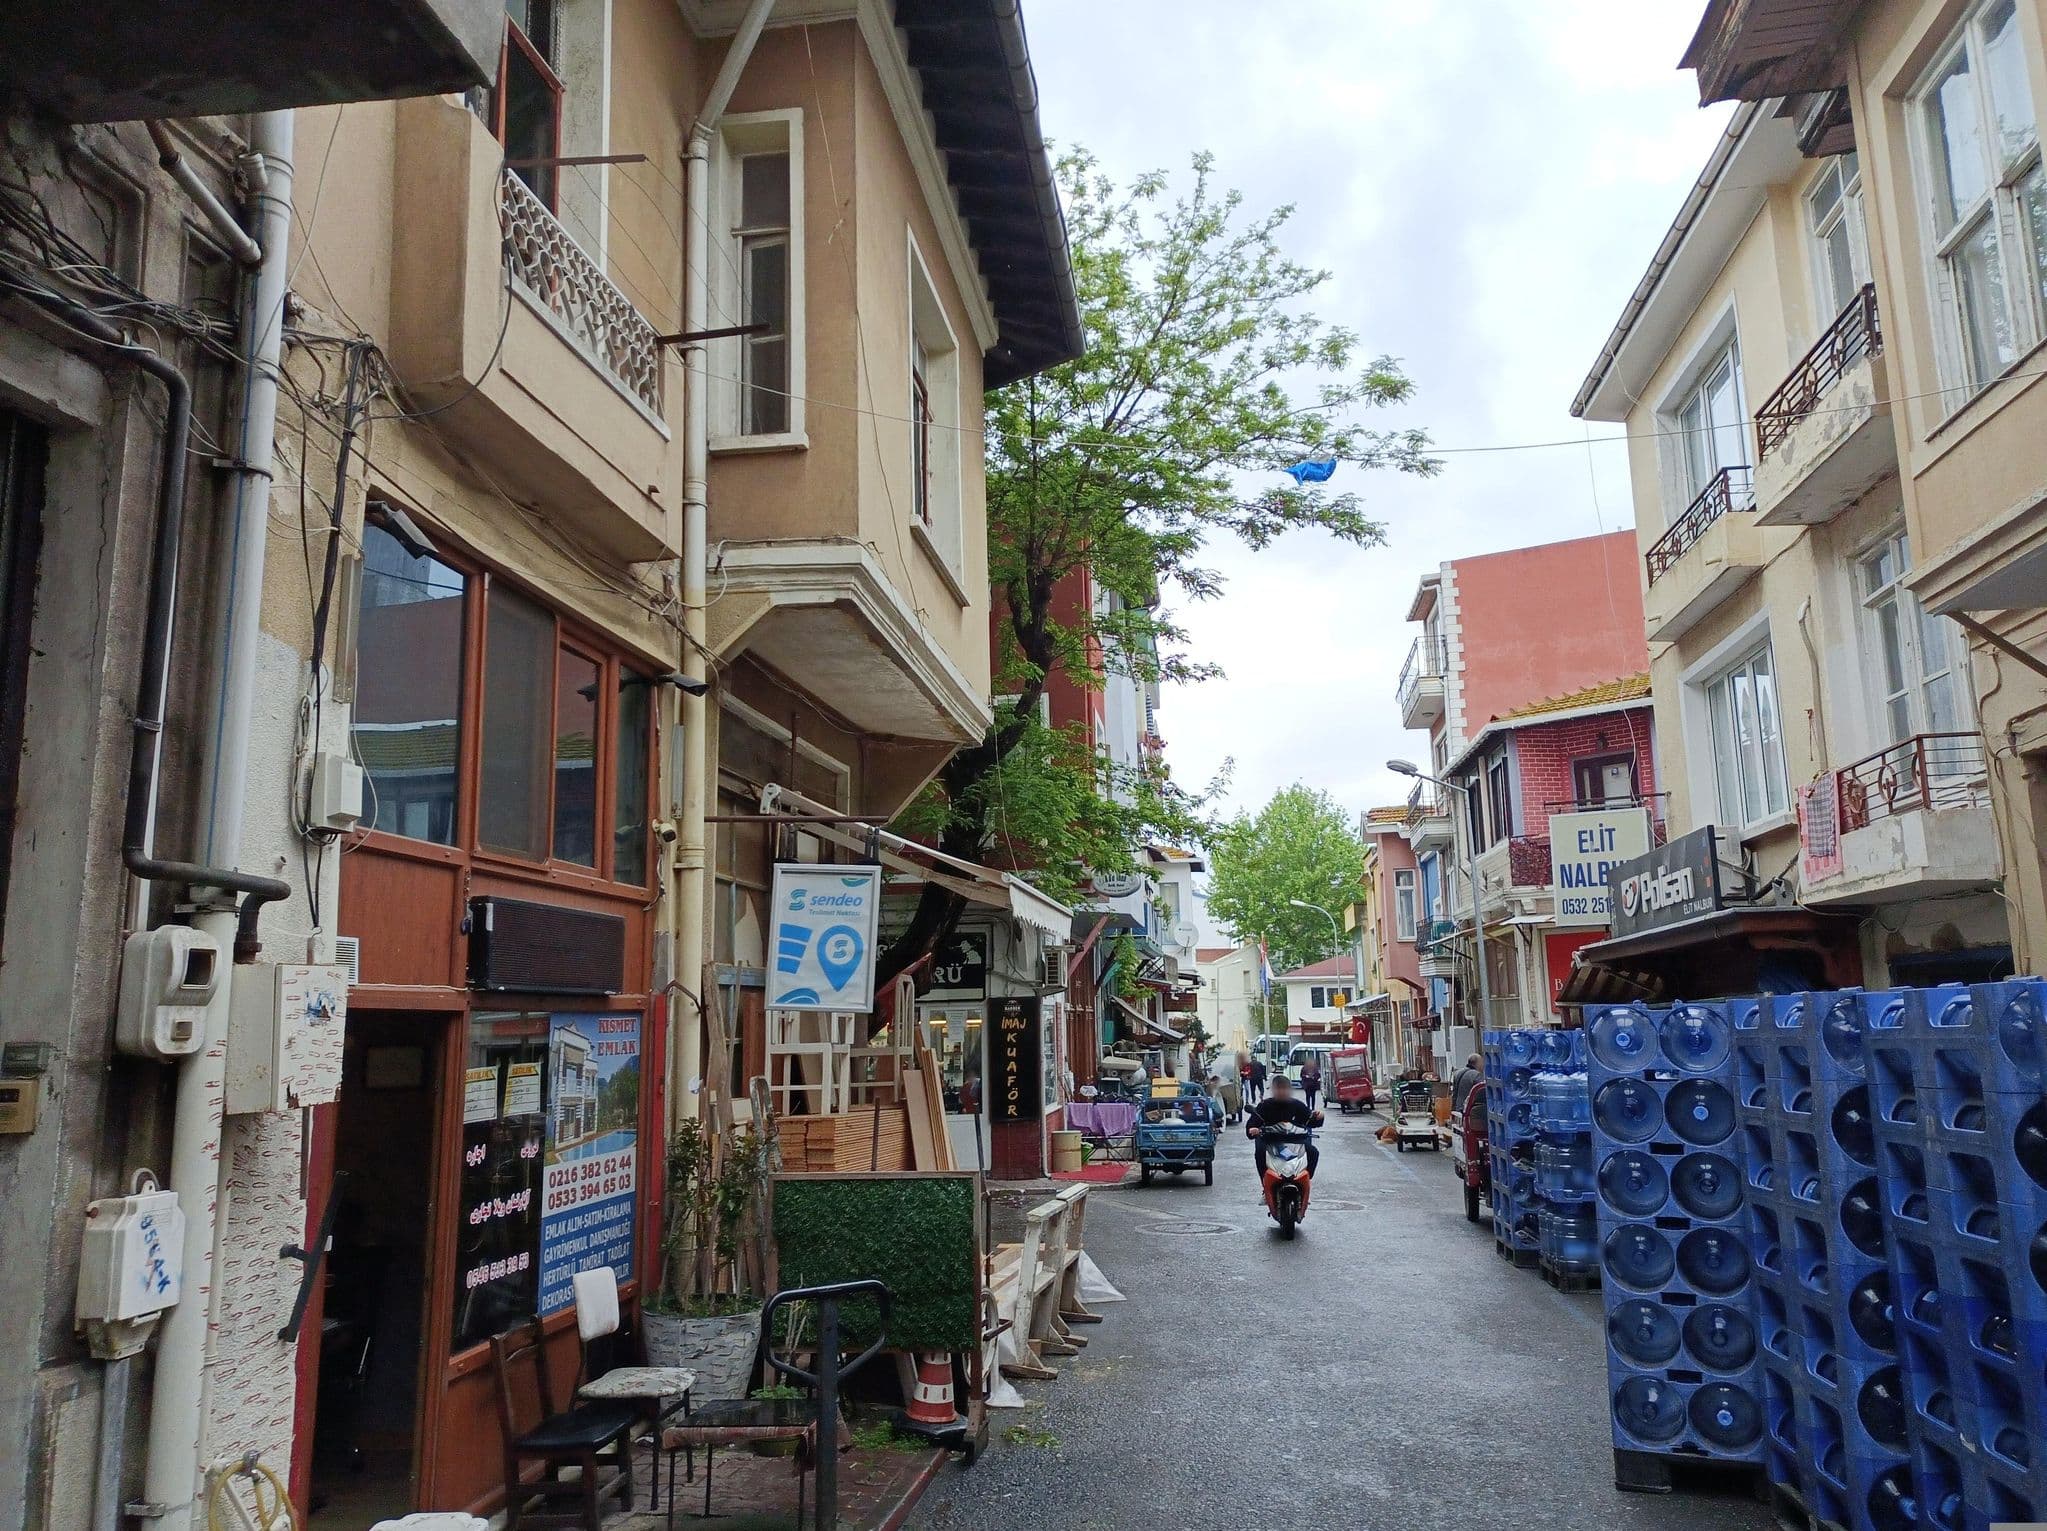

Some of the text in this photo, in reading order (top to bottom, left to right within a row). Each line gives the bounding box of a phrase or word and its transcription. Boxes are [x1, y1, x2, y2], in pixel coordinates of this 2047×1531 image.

[1578, 823, 1616, 853] ELİT
[1560, 860, 1632, 888] NALB
[810, 893, 863, 907] sendeo
[1562, 898, 1588, 914] 0532
[1555, 978, 1564, 991] B
[598, 1018, 637, 1033] KISMET
[597, 1040, 636, 1057] EMLAK
[549, 1154, 632, 1188] 0216 382 62 44
[548, 1173, 631, 1210] 0533 394 65 03
[545, 1220, 567, 1241] EMLAK
[542, 1285, 576, 1311] DEKORASY
